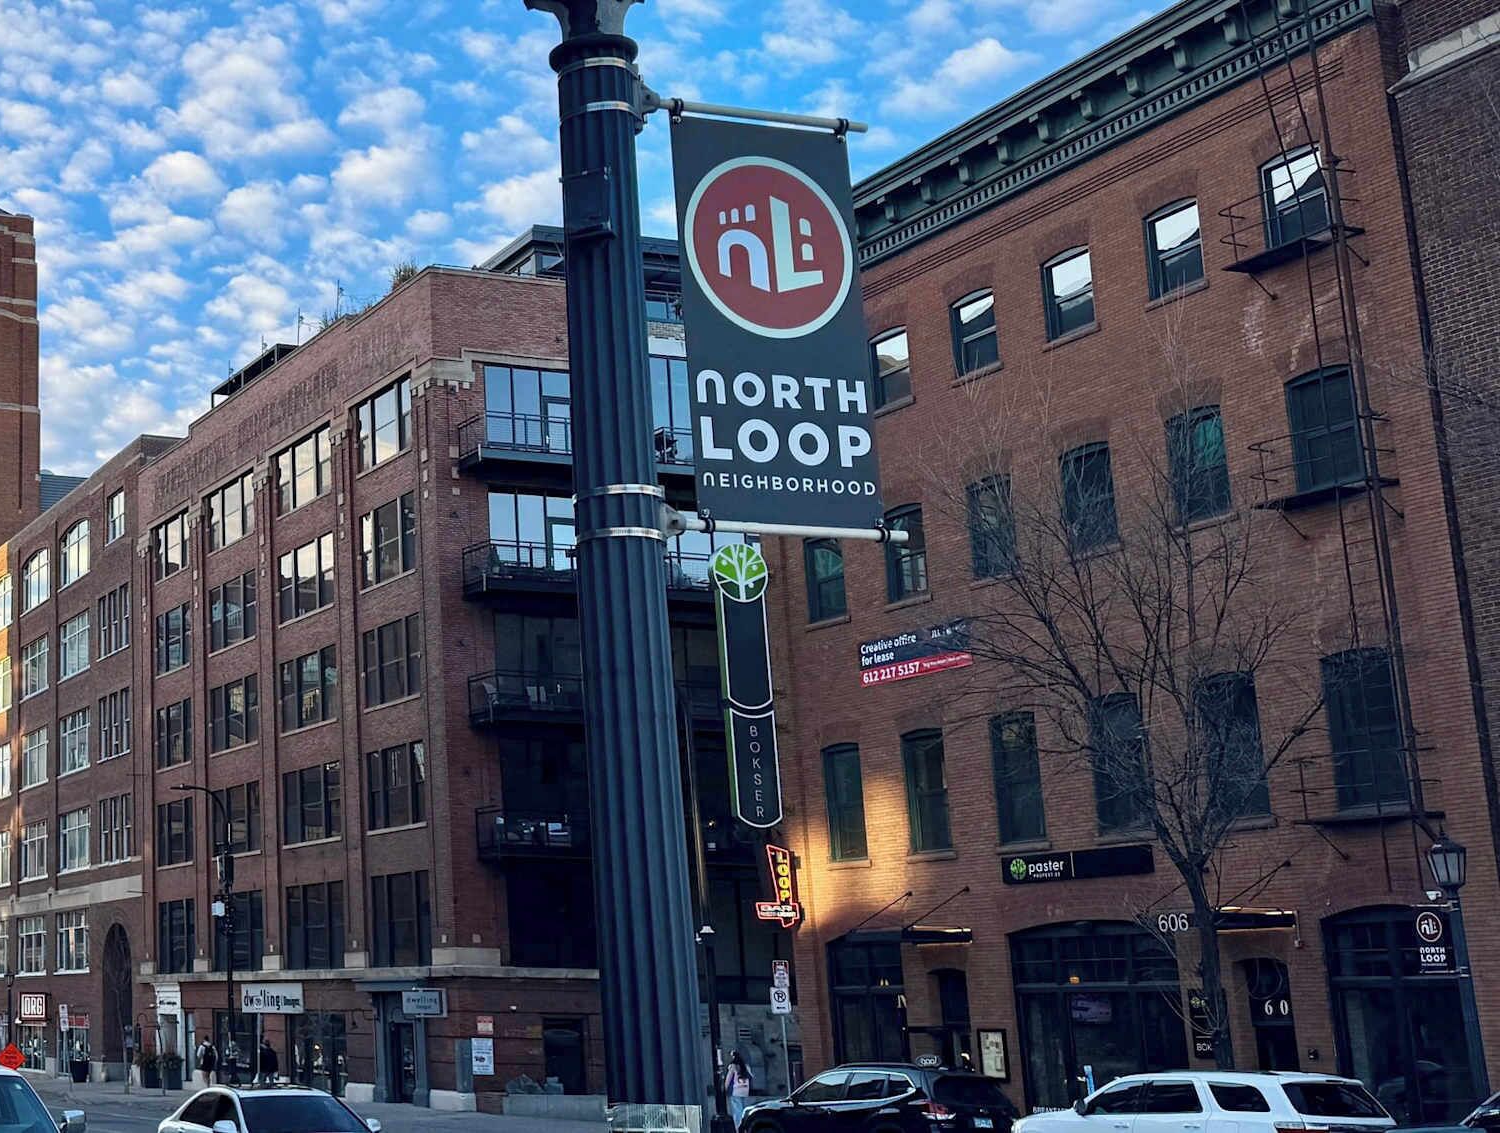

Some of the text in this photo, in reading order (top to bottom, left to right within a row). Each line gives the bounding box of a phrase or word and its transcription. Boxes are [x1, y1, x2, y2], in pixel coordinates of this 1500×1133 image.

[696, 369, 868, 414] NORTH
[699, 415, 872, 468] LOOP
[703, 470, 876, 496] NEIGHBORHOOD
[860, 638, 893, 655] Creative
[861, 651, 895, 666] for lease
[862, 661, 920, 684] 612 217 5157
[749, 725, 764, 817] BOKSER
[776, 850, 790, 902] LOOP
[1028, 860, 1064, 875] paster
[1157, 912, 1190, 932] 606
[1420, 954, 1447, 963] LOOP
[24, 997, 43, 1015] DRG
[243, 988, 281, 1011] dwlling
[1196, 1043, 1213, 1052] BOK
